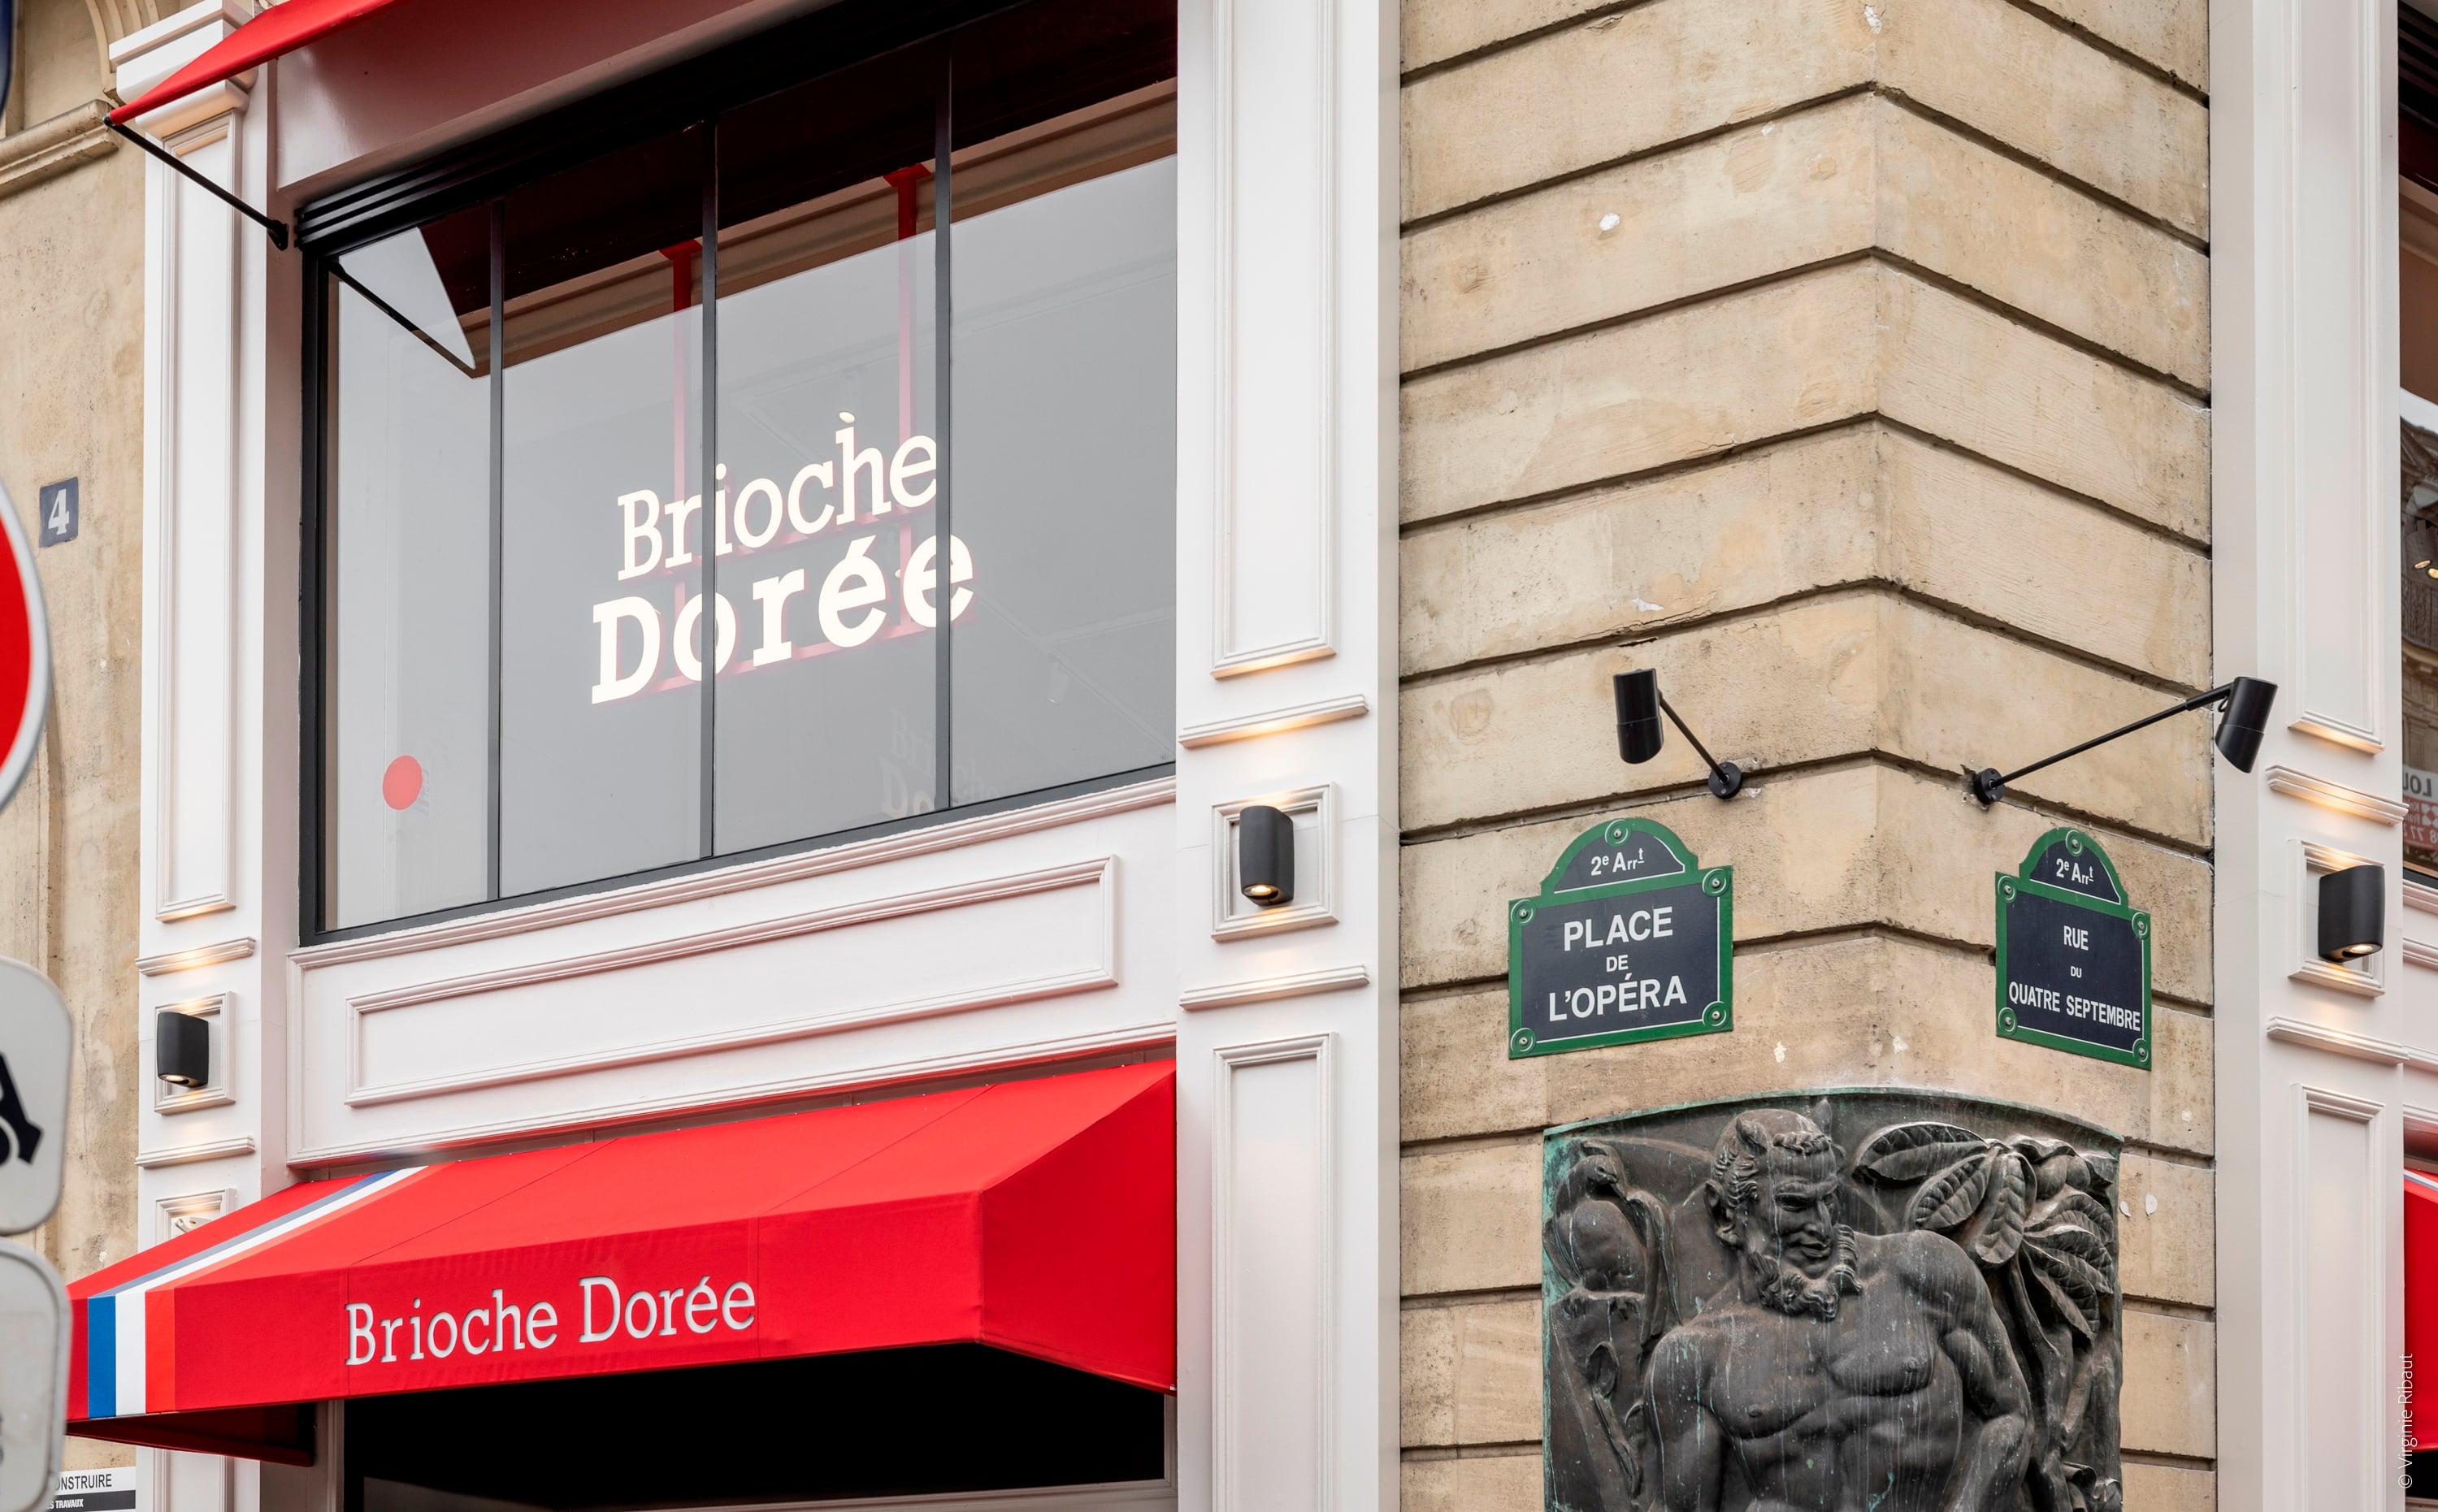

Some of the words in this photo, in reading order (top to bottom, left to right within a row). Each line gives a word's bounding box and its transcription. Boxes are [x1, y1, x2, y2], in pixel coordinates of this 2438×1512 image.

[47, 488, 70, 535] 4
[618, 412, 937, 581] Brioche
[592, 533, 975, 705] Dorée
[1590, 855, 1610, 877] 2e
[2056, 858, 2070, 878] 2e
[1564, 906, 1673, 951] PLACE
[2063, 925, 2089, 951] RUE
[1606, 954, 1629, 973] DE
[2070, 965, 2082, 978] DU
[1549, 973, 1687, 1022] L'OPÉRA
[2008, 981, 2060, 1012] QUATRE
[2066, 994, 2141, 1032] SEPTEMBRE
[345, 1289, 558, 1366] Brioche
[579, 1276, 756, 1343] Dorée
[55, 1498, 84, 1509] TRAVAUX
